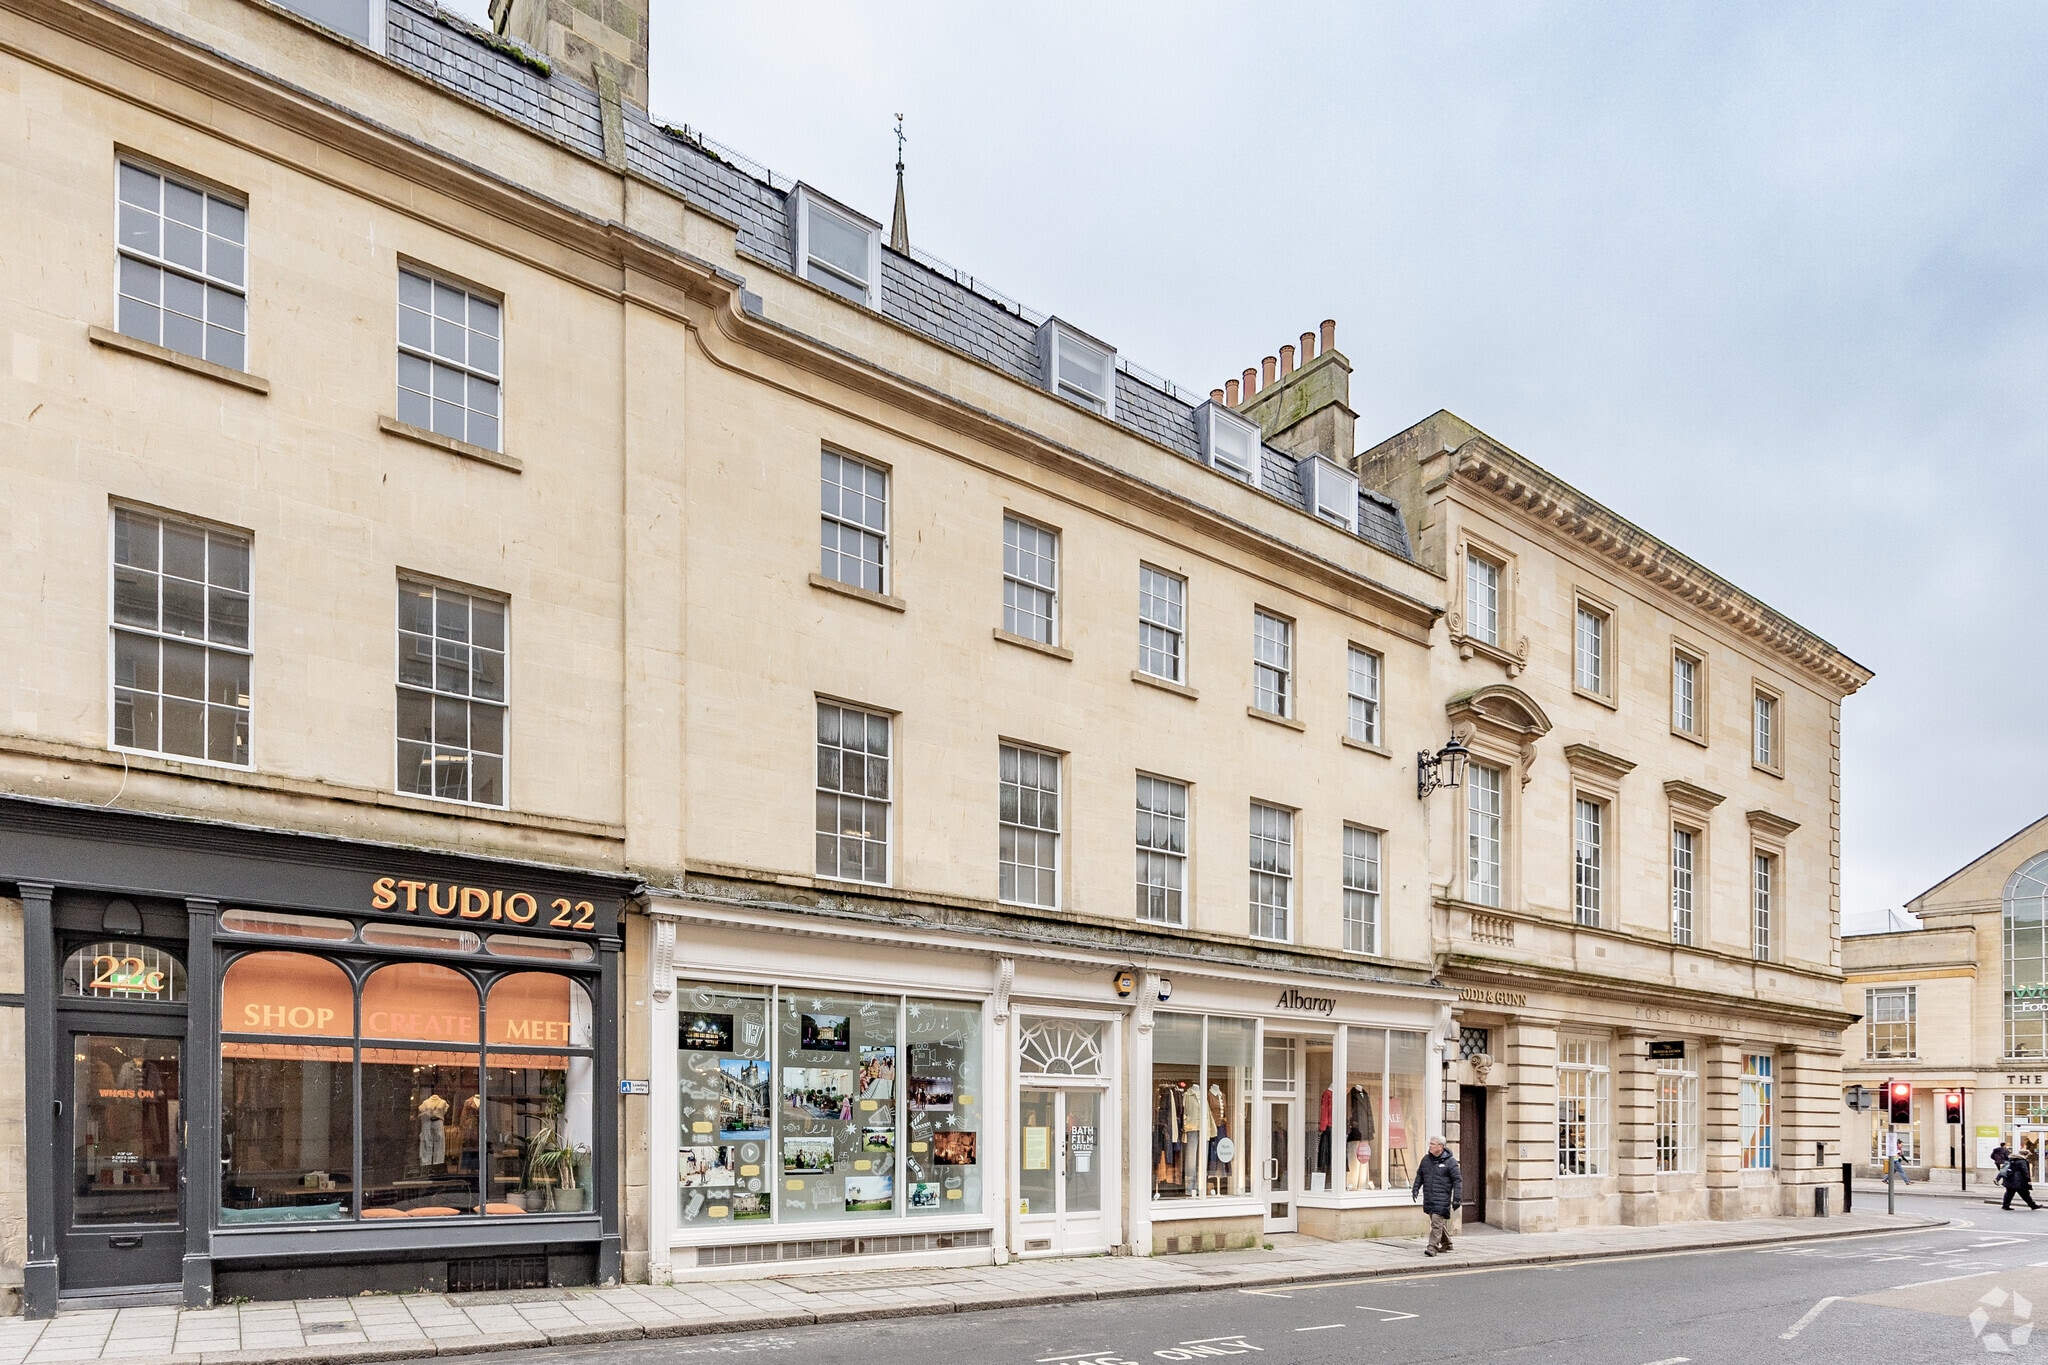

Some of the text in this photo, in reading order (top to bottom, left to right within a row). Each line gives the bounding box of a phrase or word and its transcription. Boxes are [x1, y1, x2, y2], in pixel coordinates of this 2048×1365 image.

[371, 877, 595, 930] STUDIO 22
[89, 955, 165, 992] 22c
[1276, 989, 1337, 1016] Albaray
[1459, 986, 1527, 1007] ODD & GUNN
[244, 1003, 335, 1030] SHOP
[368, 1011, 472, 1037] CREATE
[1635, 1006, 1742, 1031] POST OFFICE
[506, 1019, 571, 1042] MEET
[1054, 1060, 1065, 1071] 23
[2006, 1075, 2042, 1084] THE
[137, 1089, 154, 1099] ON
[1388, 1113, 1402, 1123] ALE
[1071, 1125, 1094, 1135] BATH
[1071, 1134, 1094, 1144] FILM
[1071, 1143, 1094, 1151] OFFICE
[1153, 1340, 1265, 1360] ONLY
